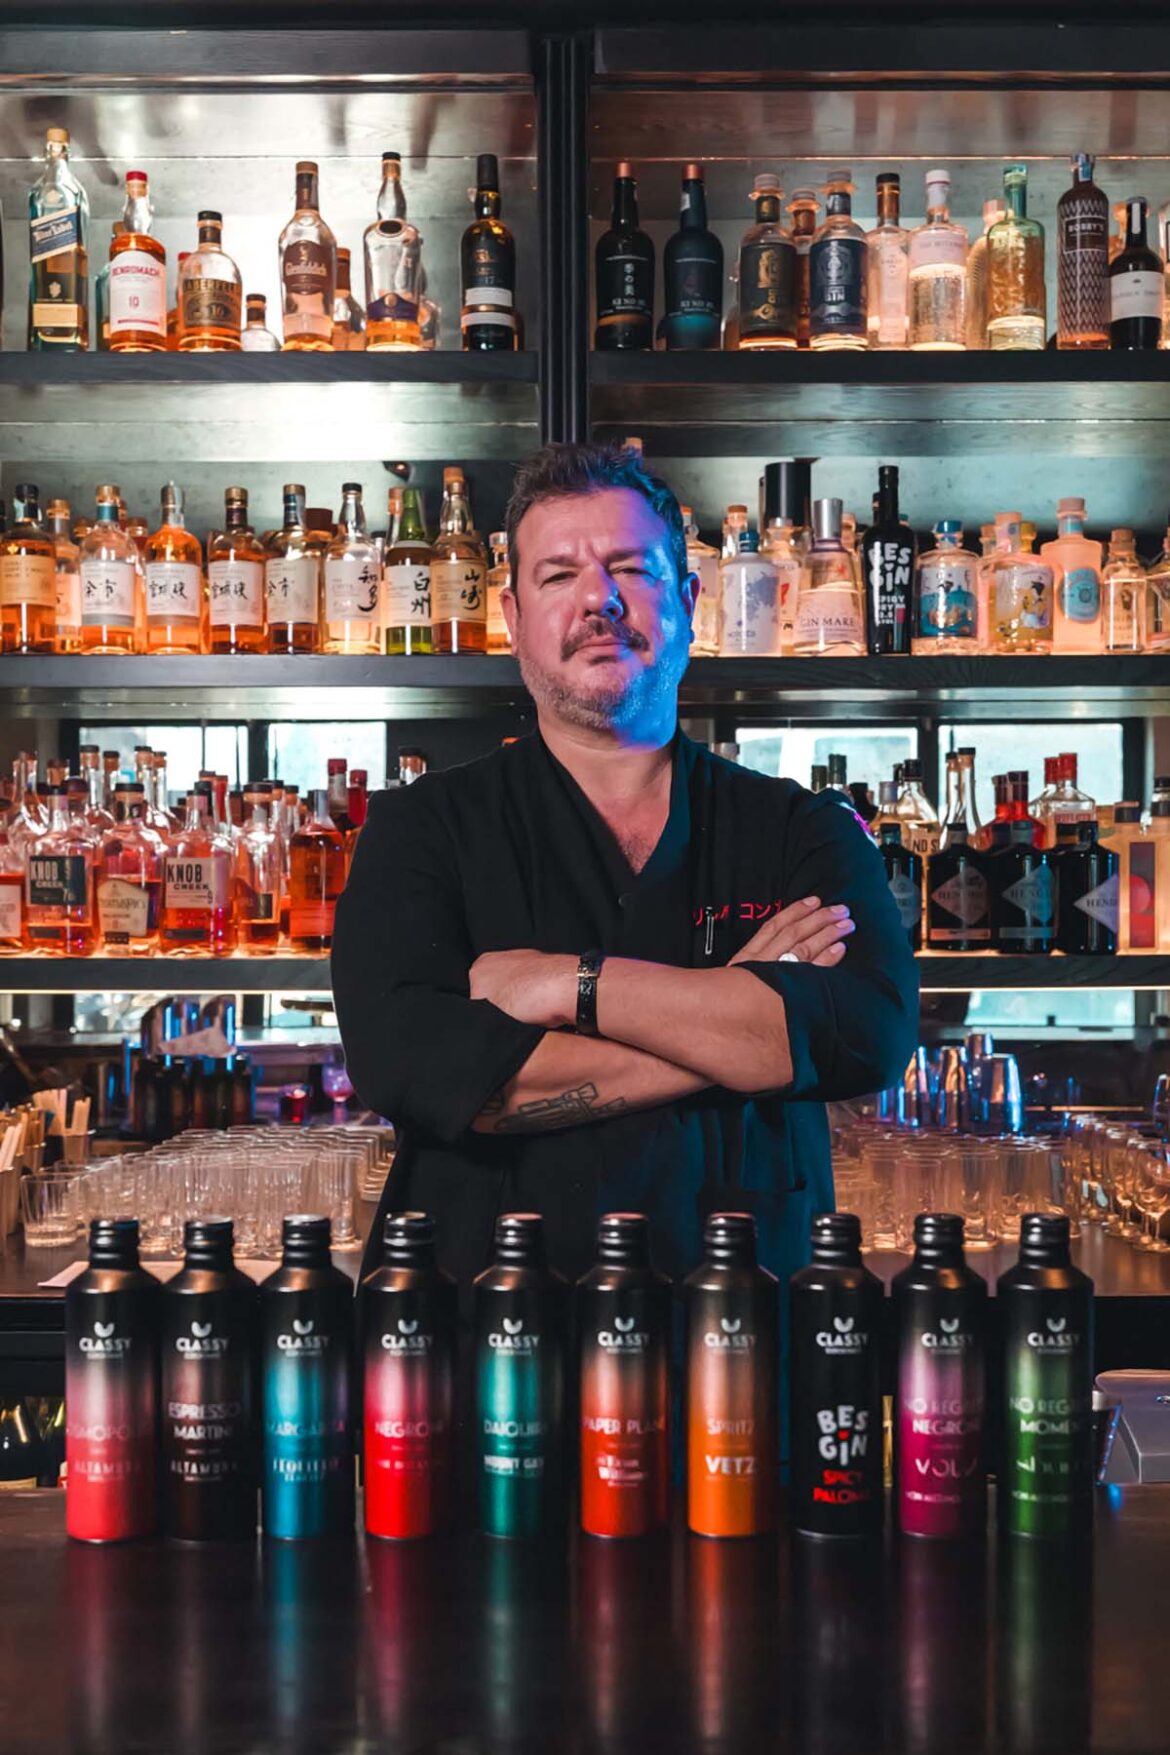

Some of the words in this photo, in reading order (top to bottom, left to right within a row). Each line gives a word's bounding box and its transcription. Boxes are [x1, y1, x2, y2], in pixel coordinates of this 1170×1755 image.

[411, 571, 431, 618] 白州
[879, 595, 904, 603] PICY
[822, 616, 855, 626] MARE
[30, 861, 58, 880] KNOB
[167, 864, 203, 883] KNOB
[36, 881, 63, 889] CREEK
[79, 1336, 132, 1352] CLASSY
[176, 1336, 229, 1352] CLASSY
[277, 1334, 329, 1350] CLASSY
[381, 1333, 434, 1350] CLASSY
[488, 1333, 540, 1348] CLASSY
[597, 1331, 650, 1347] CLASSY
[703, 1332, 756, 1348] CLASSY
[816, 1332, 868, 1347] CLASSY
[921, 1332, 974, 1347] CLASSY
[1027, 1332, 1079, 1347] CLASSY
[817, 1405, 868, 1434] BES
[174, 1425, 236, 1440] MARTIN
[375, 1419, 445, 1439] NEGRO
[818, 1434, 868, 1467] GIN
[705, 1454, 757, 1475] VETZ
[822, 1468, 863, 1486] SPICY
